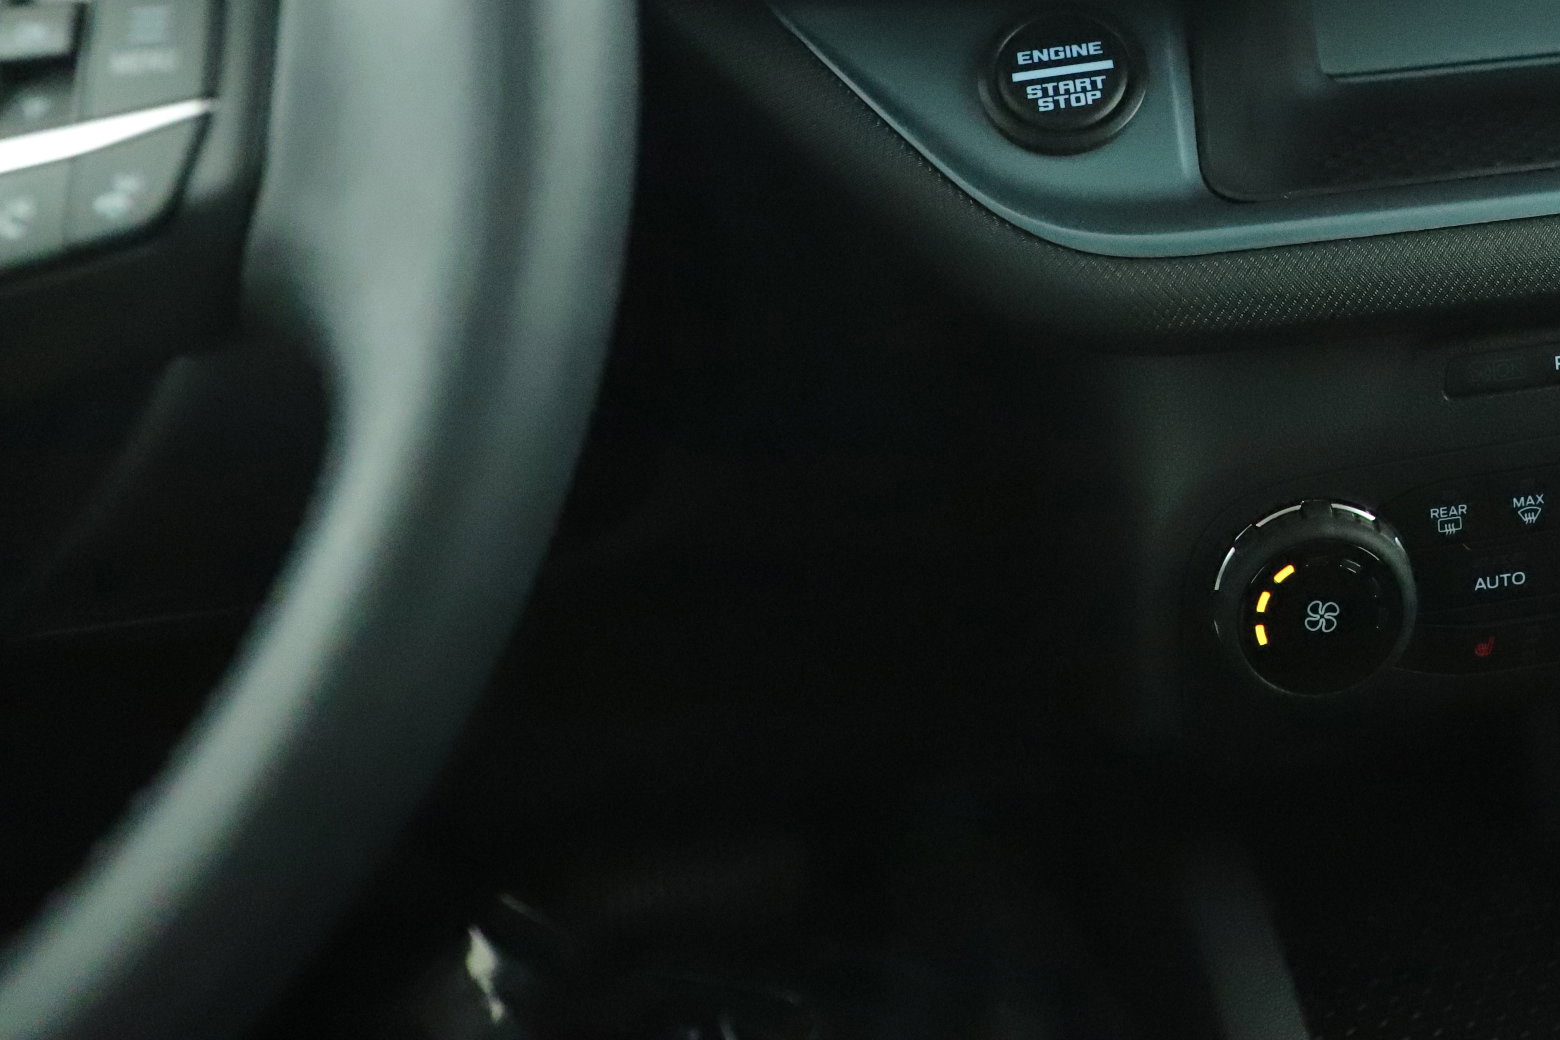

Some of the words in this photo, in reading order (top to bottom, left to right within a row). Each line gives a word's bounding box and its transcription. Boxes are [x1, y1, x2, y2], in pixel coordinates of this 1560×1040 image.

[1016, 41, 1104, 65] ENGINE
[1026, 75, 1107, 99] START
[1038, 90, 1102, 112] STOP
[1512, 493, 1545, 508] MAX
[1430, 504, 1468, 519] REAR
[1474, 571, 1526, 591] AUTO
